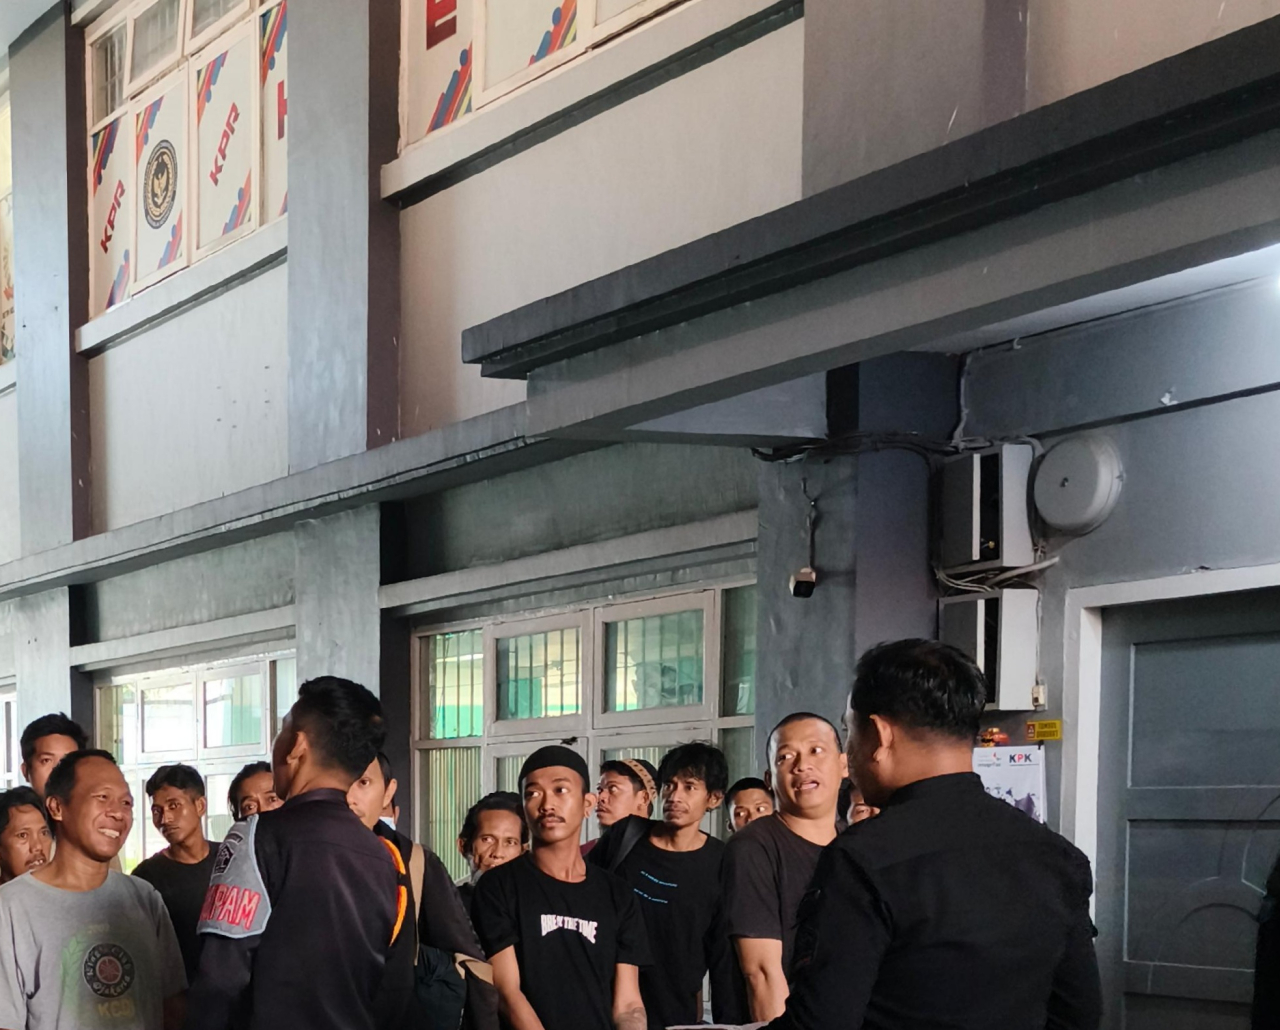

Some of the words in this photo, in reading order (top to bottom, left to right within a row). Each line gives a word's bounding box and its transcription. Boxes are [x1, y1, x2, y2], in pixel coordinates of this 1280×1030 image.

[209, 102, 240, 186] KPR
[100, 179, 126, 254] KPR
[1009, 753, 1032, 764] KPK
